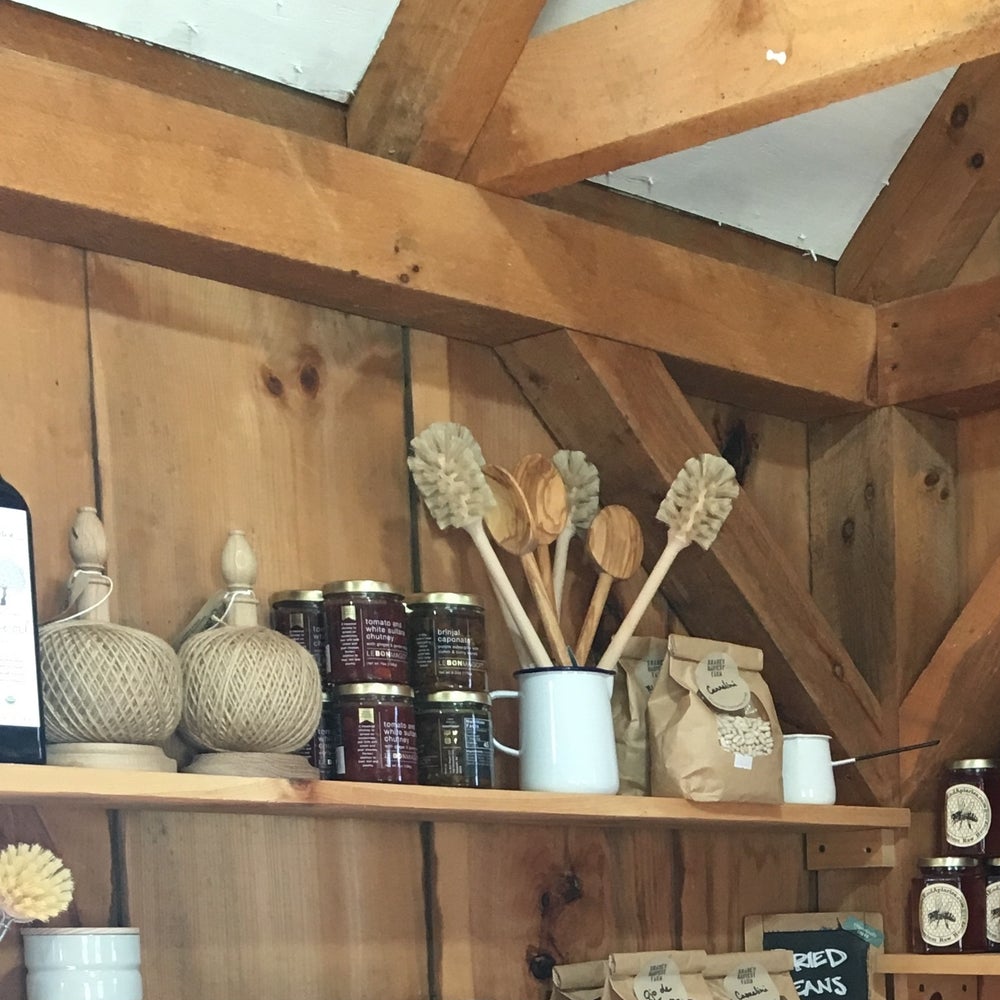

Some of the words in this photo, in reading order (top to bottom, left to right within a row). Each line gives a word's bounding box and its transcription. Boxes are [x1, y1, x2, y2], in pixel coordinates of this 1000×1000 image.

[365, 618, 391, 627] tomato
[365, 634, 394, 642] chutney
[437, 629, 461, 637] brinjal
[793, 948, 848, 971] RIED
[659, 983, 672, 994] de
[793, 976, 848, 997] EANS
